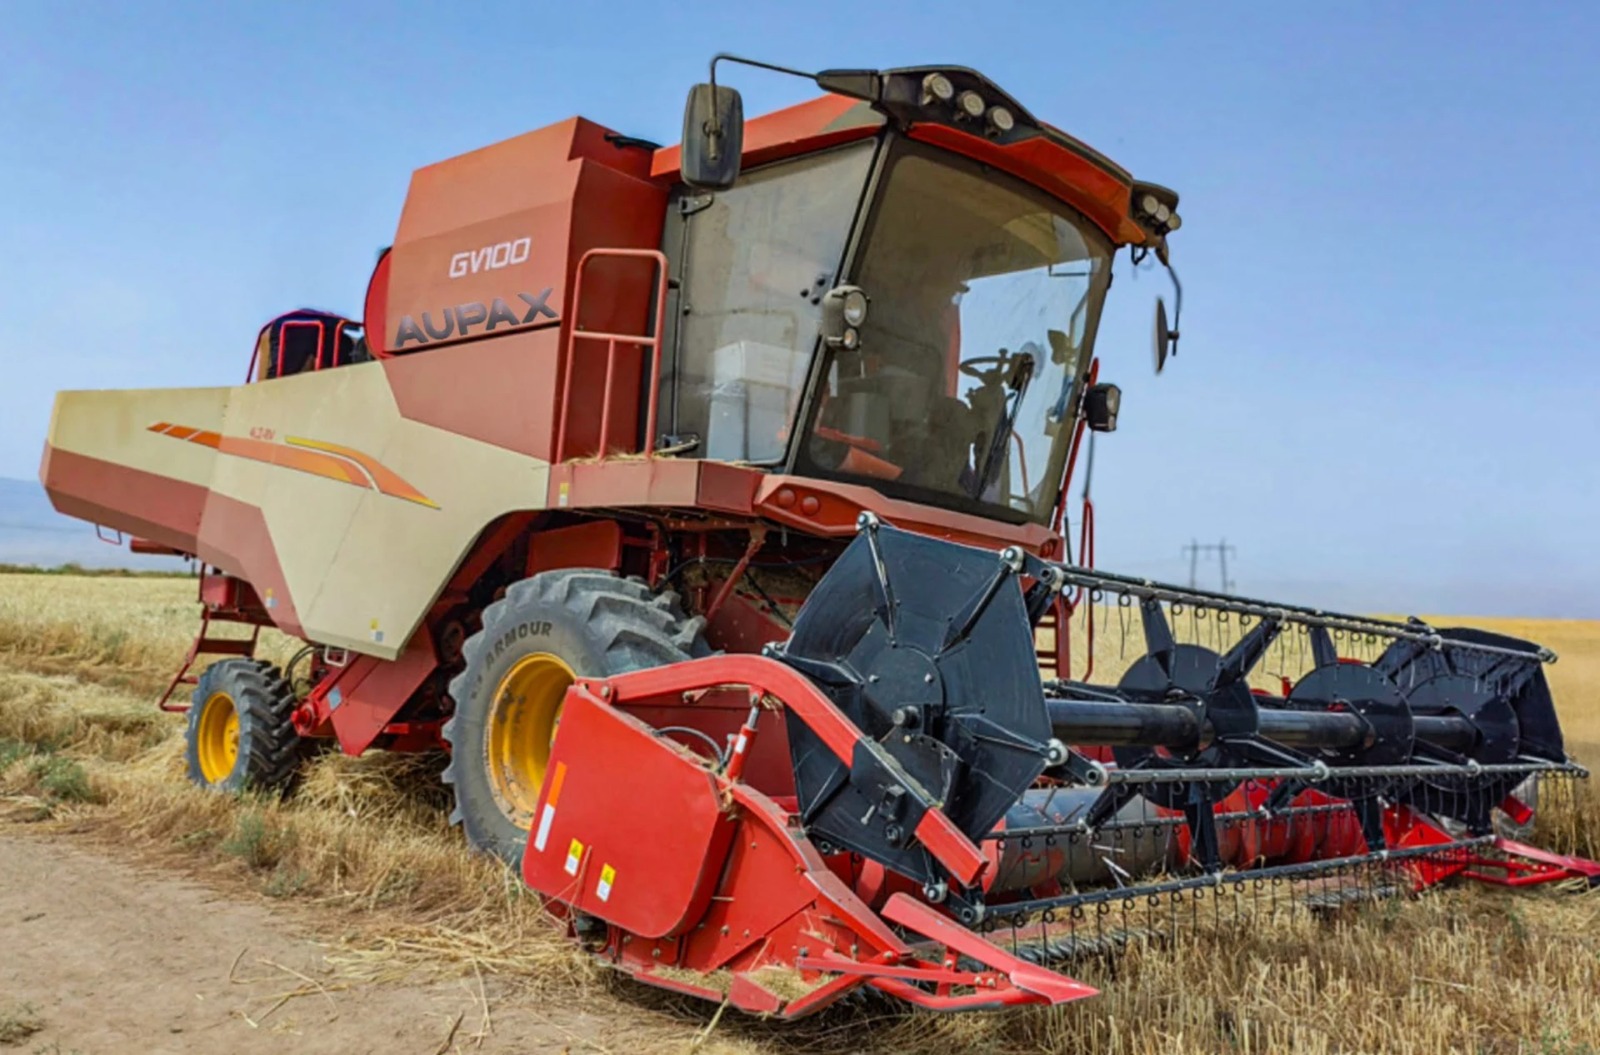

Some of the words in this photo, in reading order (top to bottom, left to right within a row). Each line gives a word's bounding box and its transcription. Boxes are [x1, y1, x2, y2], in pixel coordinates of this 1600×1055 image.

[449, 237, 531, 278] GV100
[395, 287, 558, 348] AUPAX
[485, 620, 553, 670] ARMOUR
